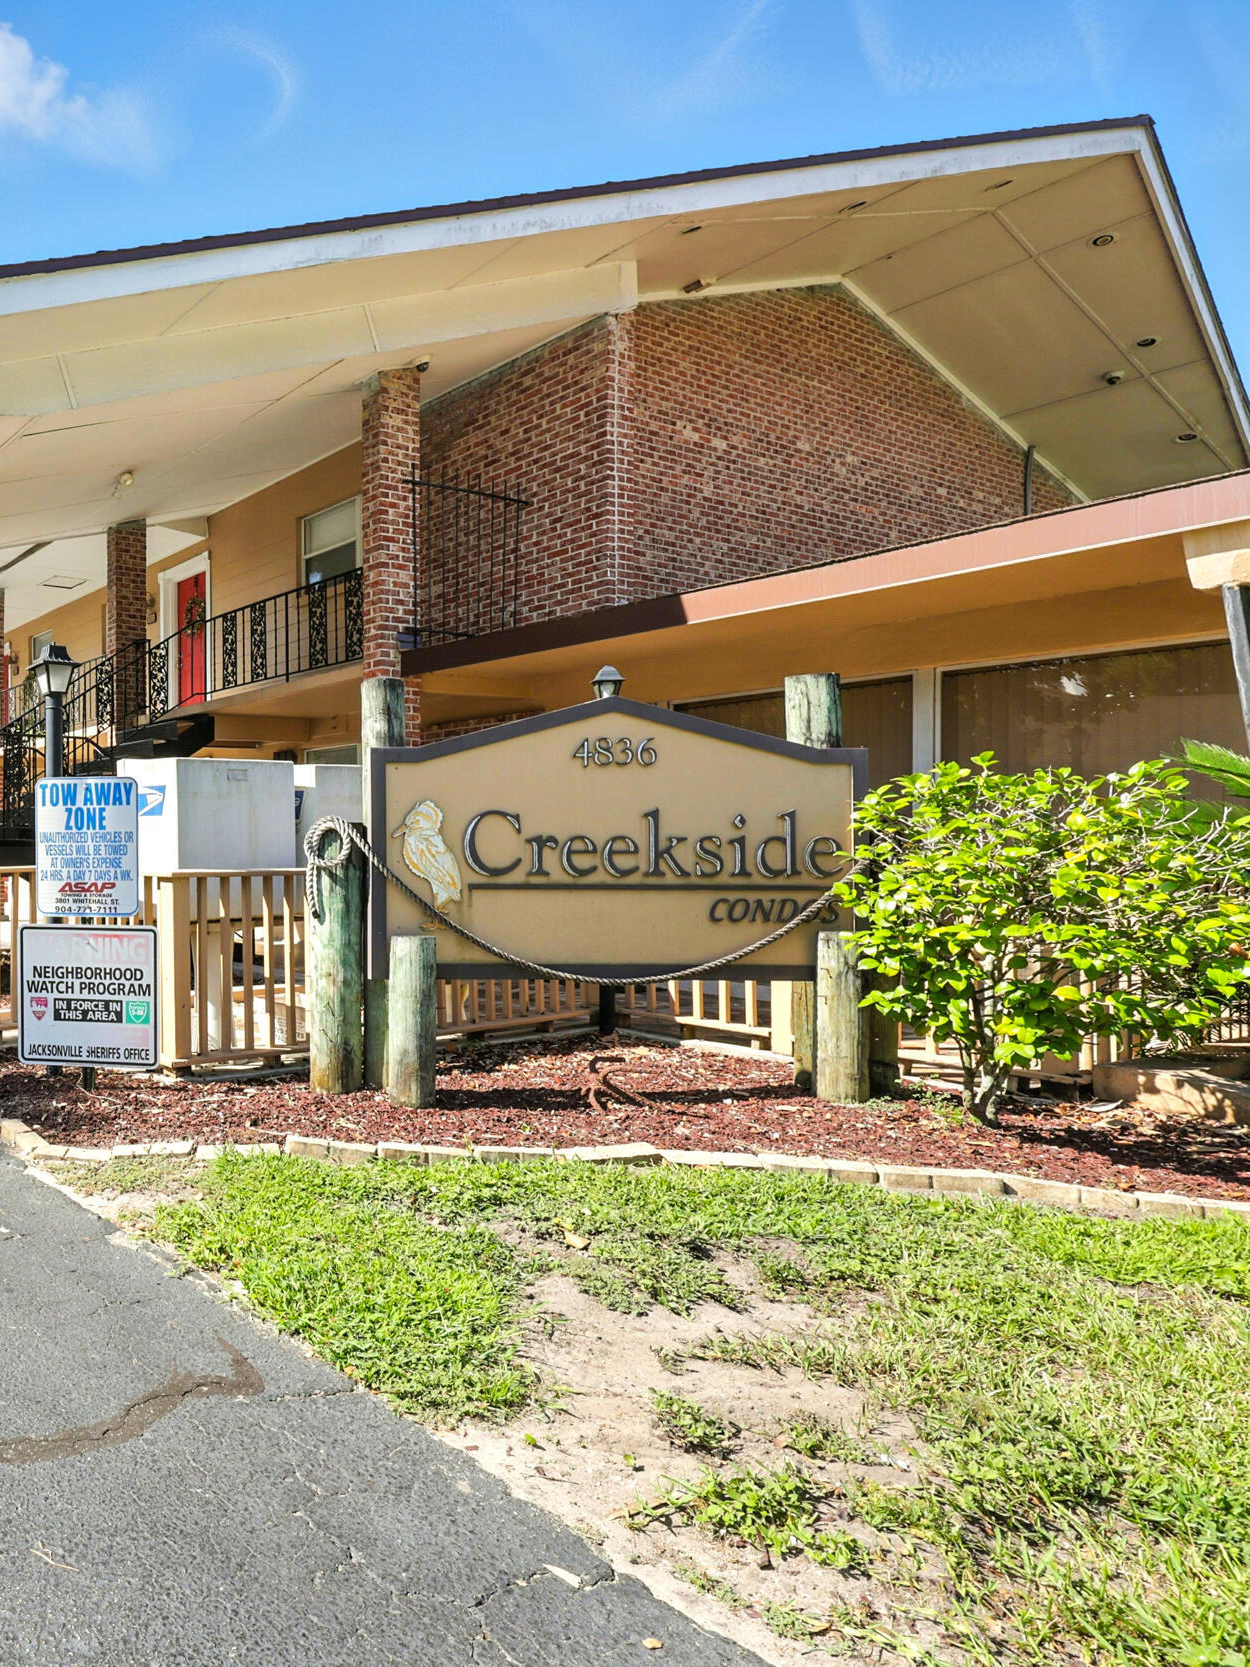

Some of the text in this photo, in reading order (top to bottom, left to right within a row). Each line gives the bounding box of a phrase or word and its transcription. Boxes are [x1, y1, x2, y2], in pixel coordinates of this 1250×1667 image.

[573, 736, 657, 768] 4836
[39, 782, 134, 806] TOW AWAY
[64, 807, 107, 831] ZONE
[39, 831, 134, 844] UNAUTHORIZED VEHICLES OR
[462, 807, 845, 878] Creekside
[45, 844, 128, 856] VESSELS WILL BE TOWED
[50, 857, 123, 869] AT OWNER'S EXPENSE
[40, 870, 134, 881] 24 HRS. A DAY 7 DAYS A WK.
[58, 882, 117, 893] ASAP
[33, 966, 143, 980] NEIGHBORHOOD
[27, 981, 151, 997] WATCH PROGRAM
[55, 1001, 67, 1010] IN
[71, 1001, 105, 1011] FORCE
[109, 1003, 121, 1012] IN
[59, 1010, 117, 1021] THIS AREA
[28, 1044, 150, 1061] JACKSONVILLE SHERIFFS OFFICE
